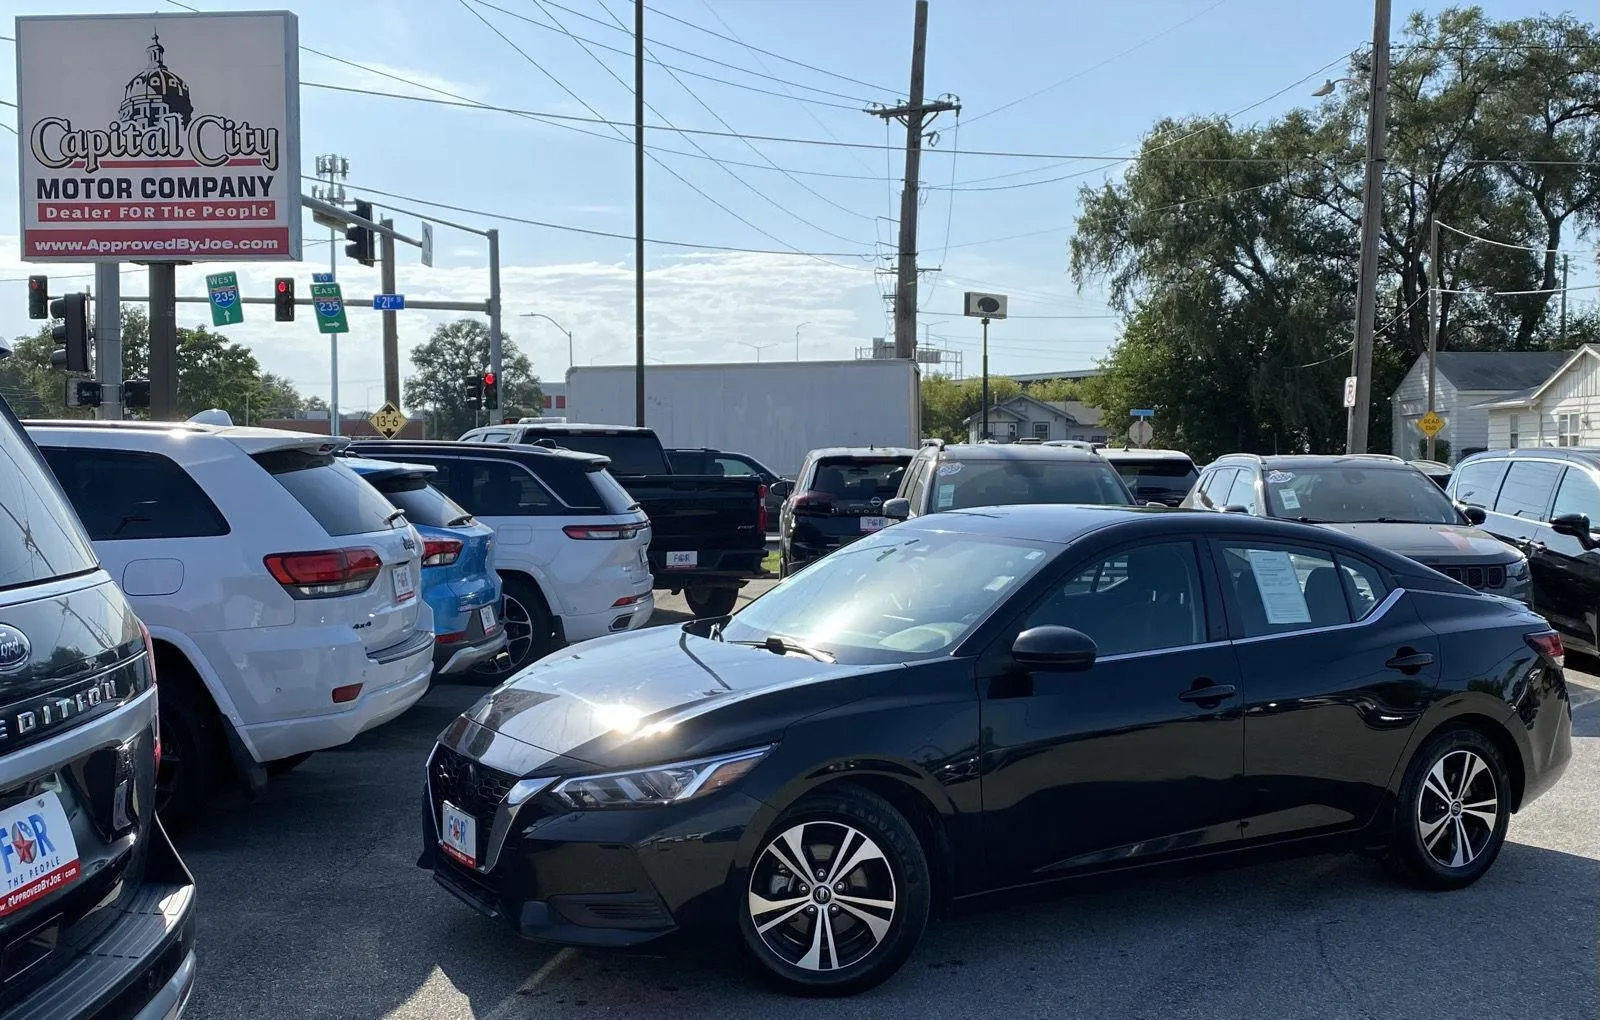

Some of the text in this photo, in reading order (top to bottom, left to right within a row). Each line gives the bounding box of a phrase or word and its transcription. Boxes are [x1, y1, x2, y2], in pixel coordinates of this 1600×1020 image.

[30, 114, 279, 173] Capital City
[37, 175, 274, 200] MOTOR COMPANY
[46, 204, 269, 219] Dealer FOR The People
[34, 238, 279, 252] www.ApprovedByJoe.com
[210, 275, 234, 285] WEST
[215, 290, 236, 303] 235
[314, 286, 337, 295] EAST
[319, 301, 340, 312] 235
[7, 855, 60, 889] THE PEOPLE
